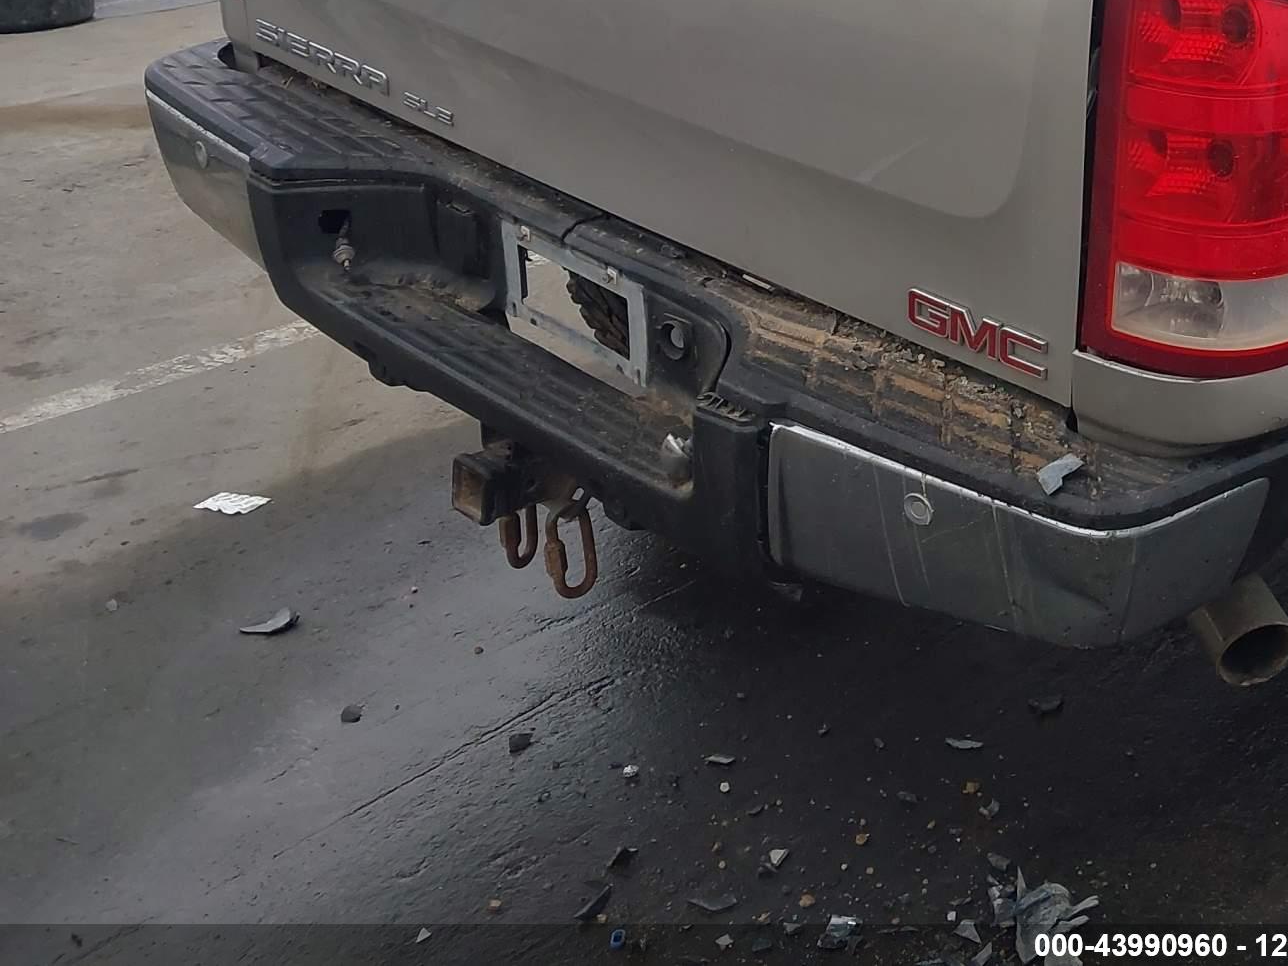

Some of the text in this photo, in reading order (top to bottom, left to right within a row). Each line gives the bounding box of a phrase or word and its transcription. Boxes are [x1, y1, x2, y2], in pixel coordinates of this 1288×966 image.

[255, 18, 454, 127] SIERRA SLE
[907, 287, 1048, 379] GMC
